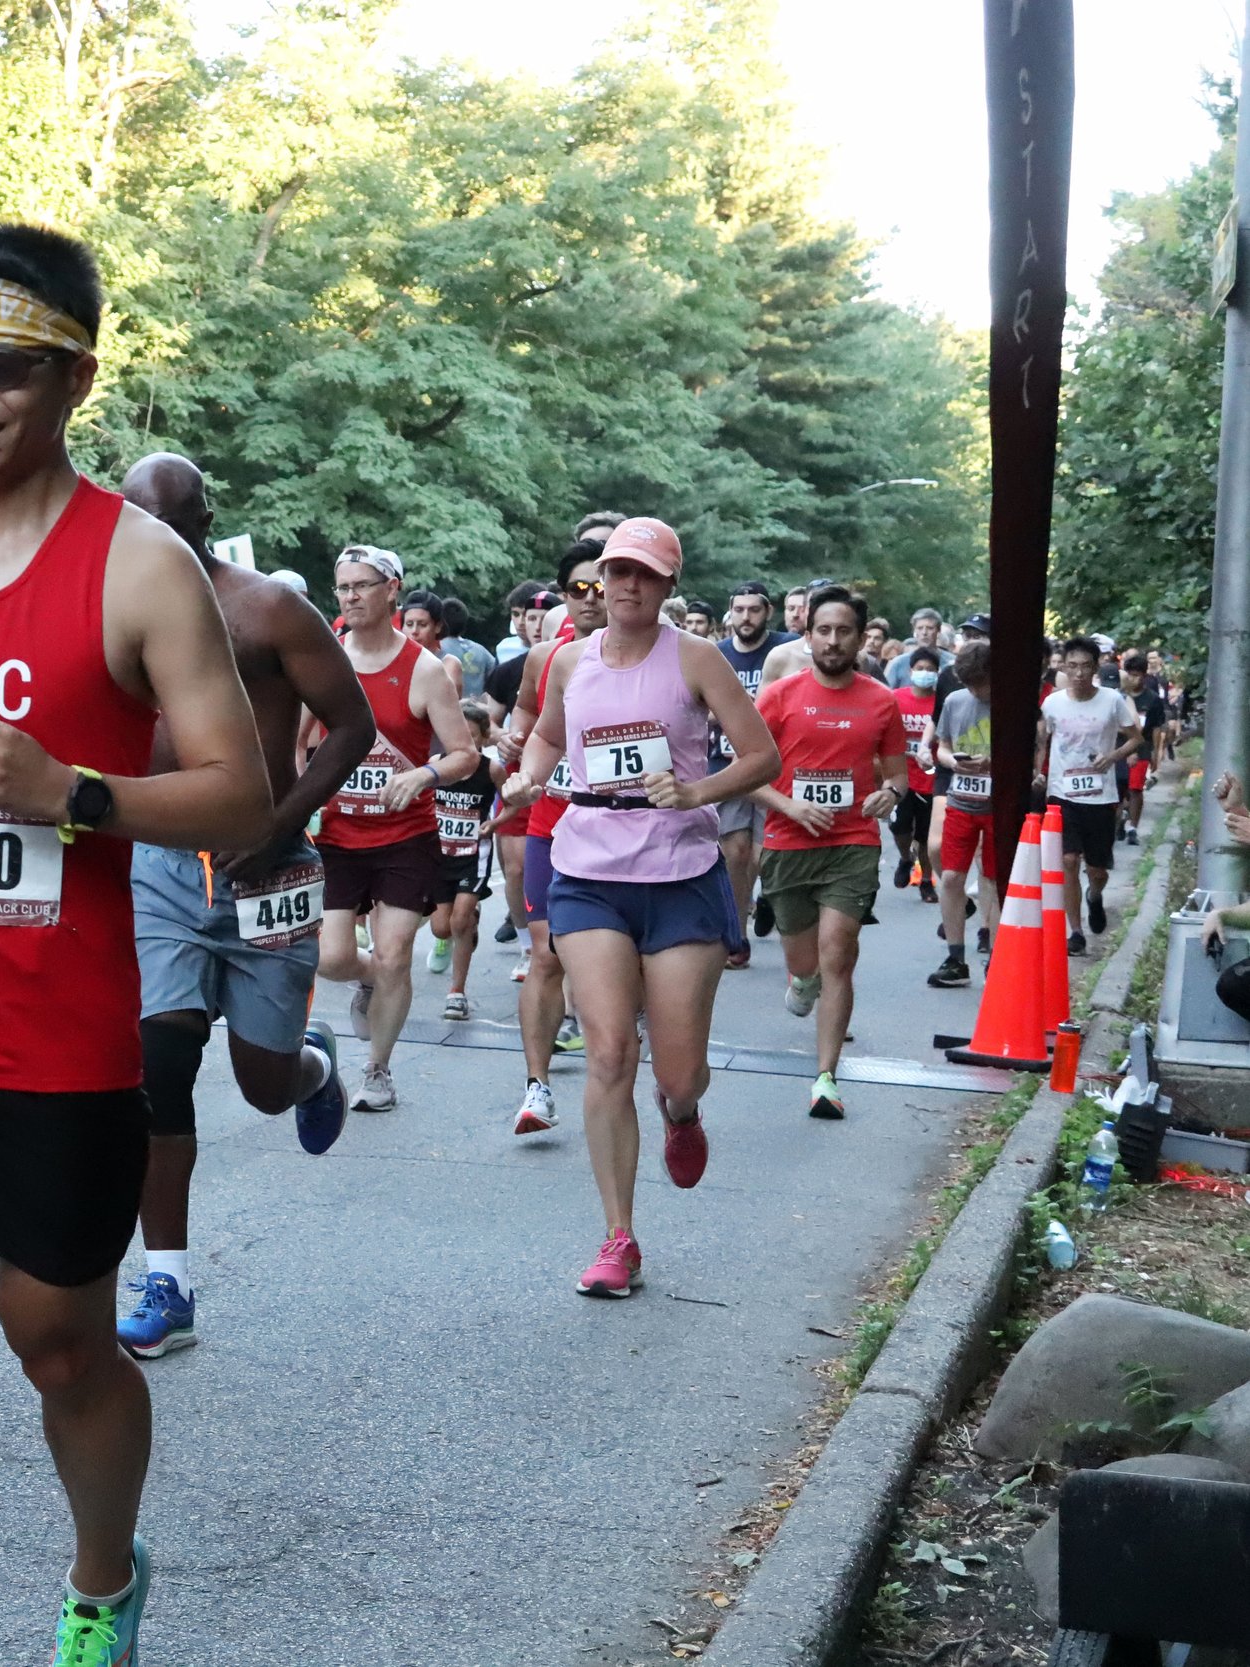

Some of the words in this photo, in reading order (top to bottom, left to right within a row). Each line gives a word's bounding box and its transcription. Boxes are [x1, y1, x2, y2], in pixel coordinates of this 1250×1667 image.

[609, 745, 644, 776] 75
[345, 769, 388, 791] 963
[956, 776, 987, 793] 2951
[1071, 776, 1094, 790] 912
[803, 784, 842, 804] 458
[21, 903, 51, 916] CLUB
[256, 890, 310, 931] 449
